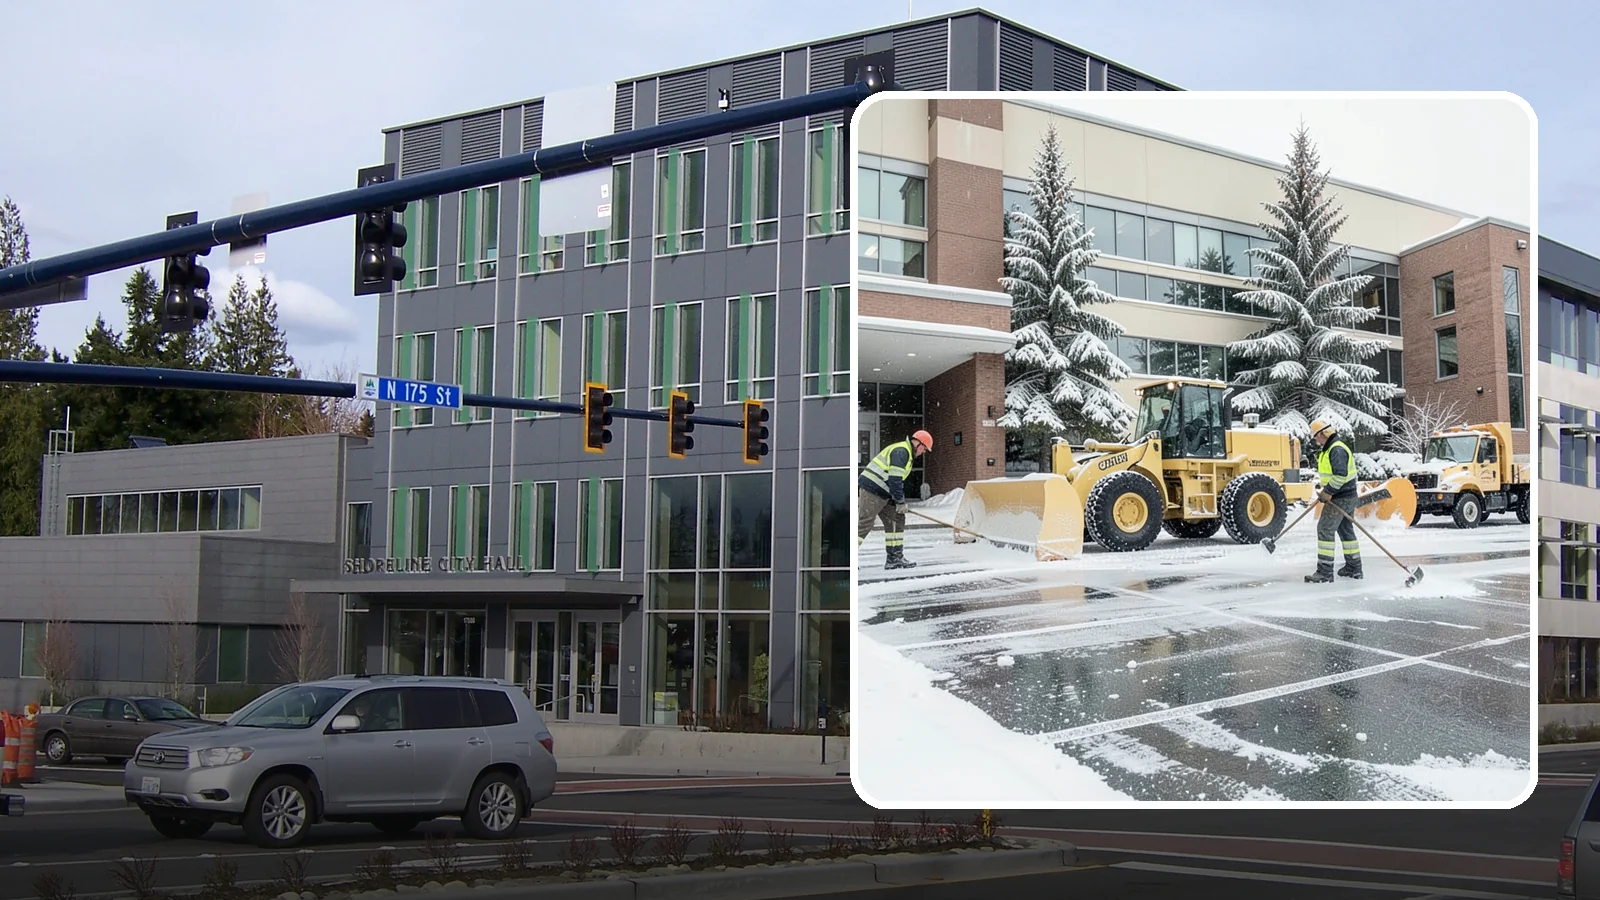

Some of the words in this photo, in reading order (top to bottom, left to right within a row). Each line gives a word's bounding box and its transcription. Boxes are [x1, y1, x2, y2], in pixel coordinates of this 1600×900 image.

[387, 380, 396, 400] N
[405, 382, 427, 403] 175
[436, 386, 451, 406] St
[344, 558, 431, 574] SHORELINE
[438, 556, 475, 572] CITY
[484, 556, 525, 571] HALL
